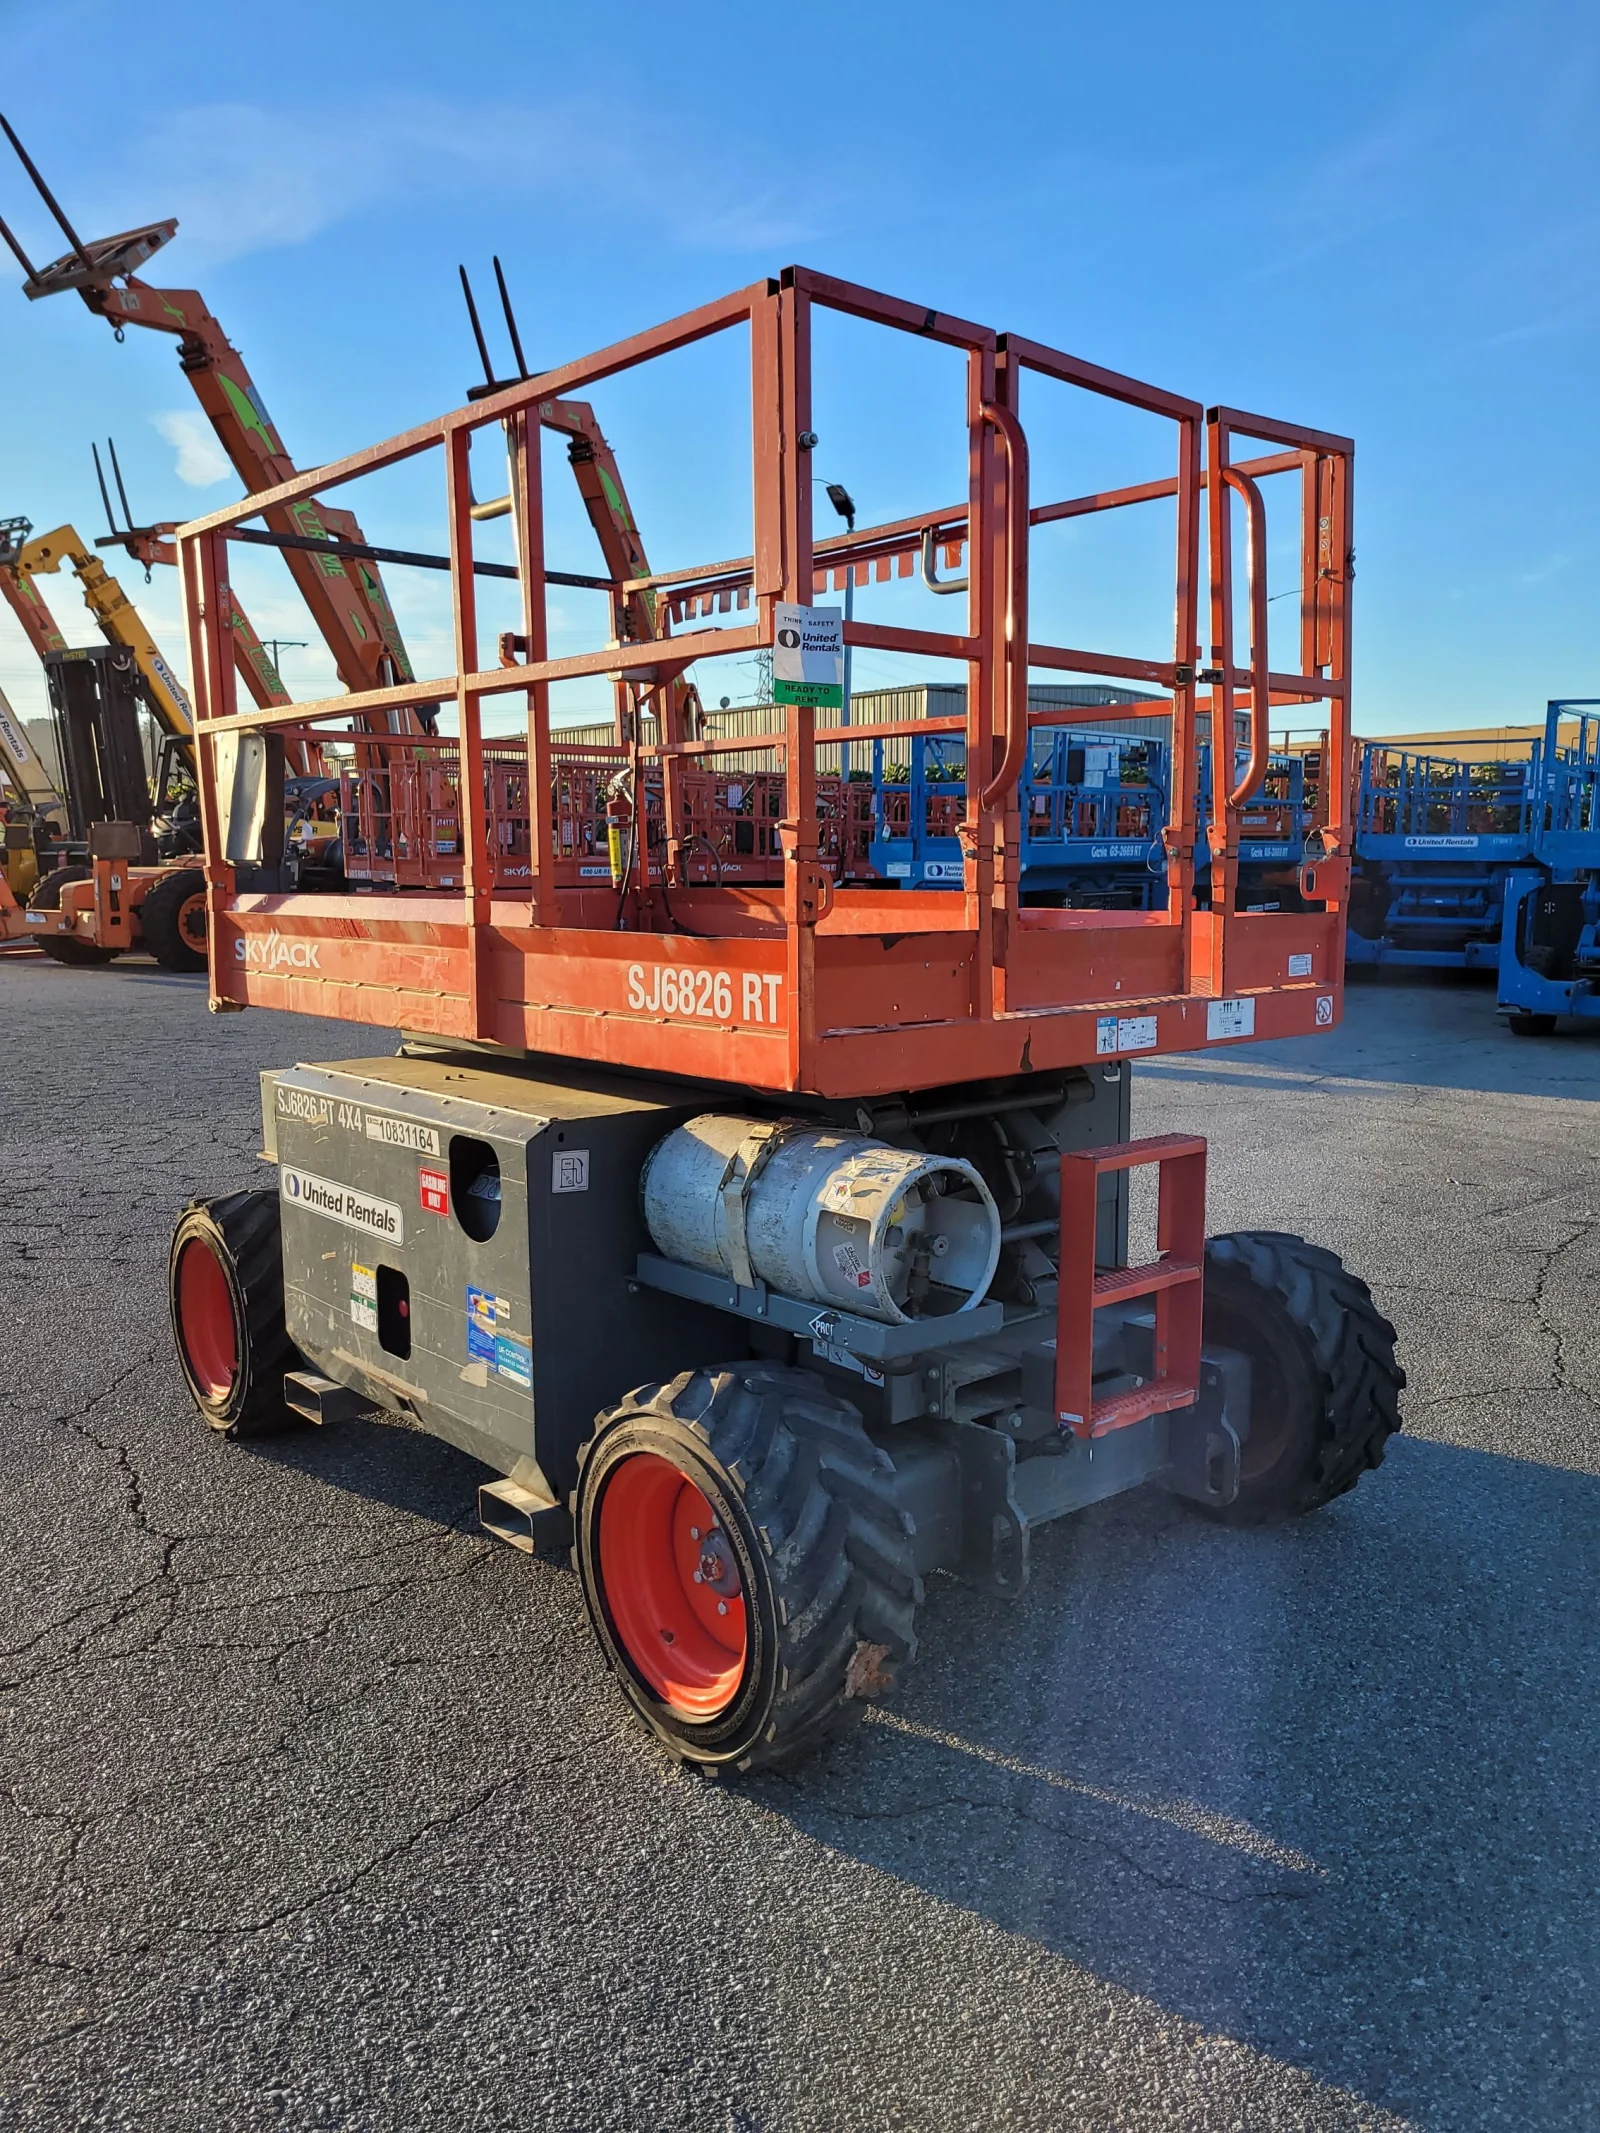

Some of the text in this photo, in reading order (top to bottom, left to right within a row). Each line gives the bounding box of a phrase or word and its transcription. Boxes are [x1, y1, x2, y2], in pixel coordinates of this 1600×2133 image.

[783, 616, 803, 625] THINK
[802, 632, 840, 642] United
[802, 644, 840, 652] Rentals
[160, 672, 183, 707] United
[785, 685, 830, 695] READY TO
[1091, 845, 1109, 857] Genie
[234, 927, 321, 970] SKYJACK
[628, 964, 783, 1023] SJ6826 RT
[277, 1087, 317, 1119] SJ6826
[338, 1103, 363, 1133] 4X4
[379, 1119, 434, 1151] 10831164
[421, 1172, 447, 1194] GASOLINE
[302, 1179, 396, 1233] United Rentals
[428, 1191, 441, 1209] ONLY
[847, 1246, 861, 1269] CAUTION
[505, 1347, 527, 1365] CONTROL
